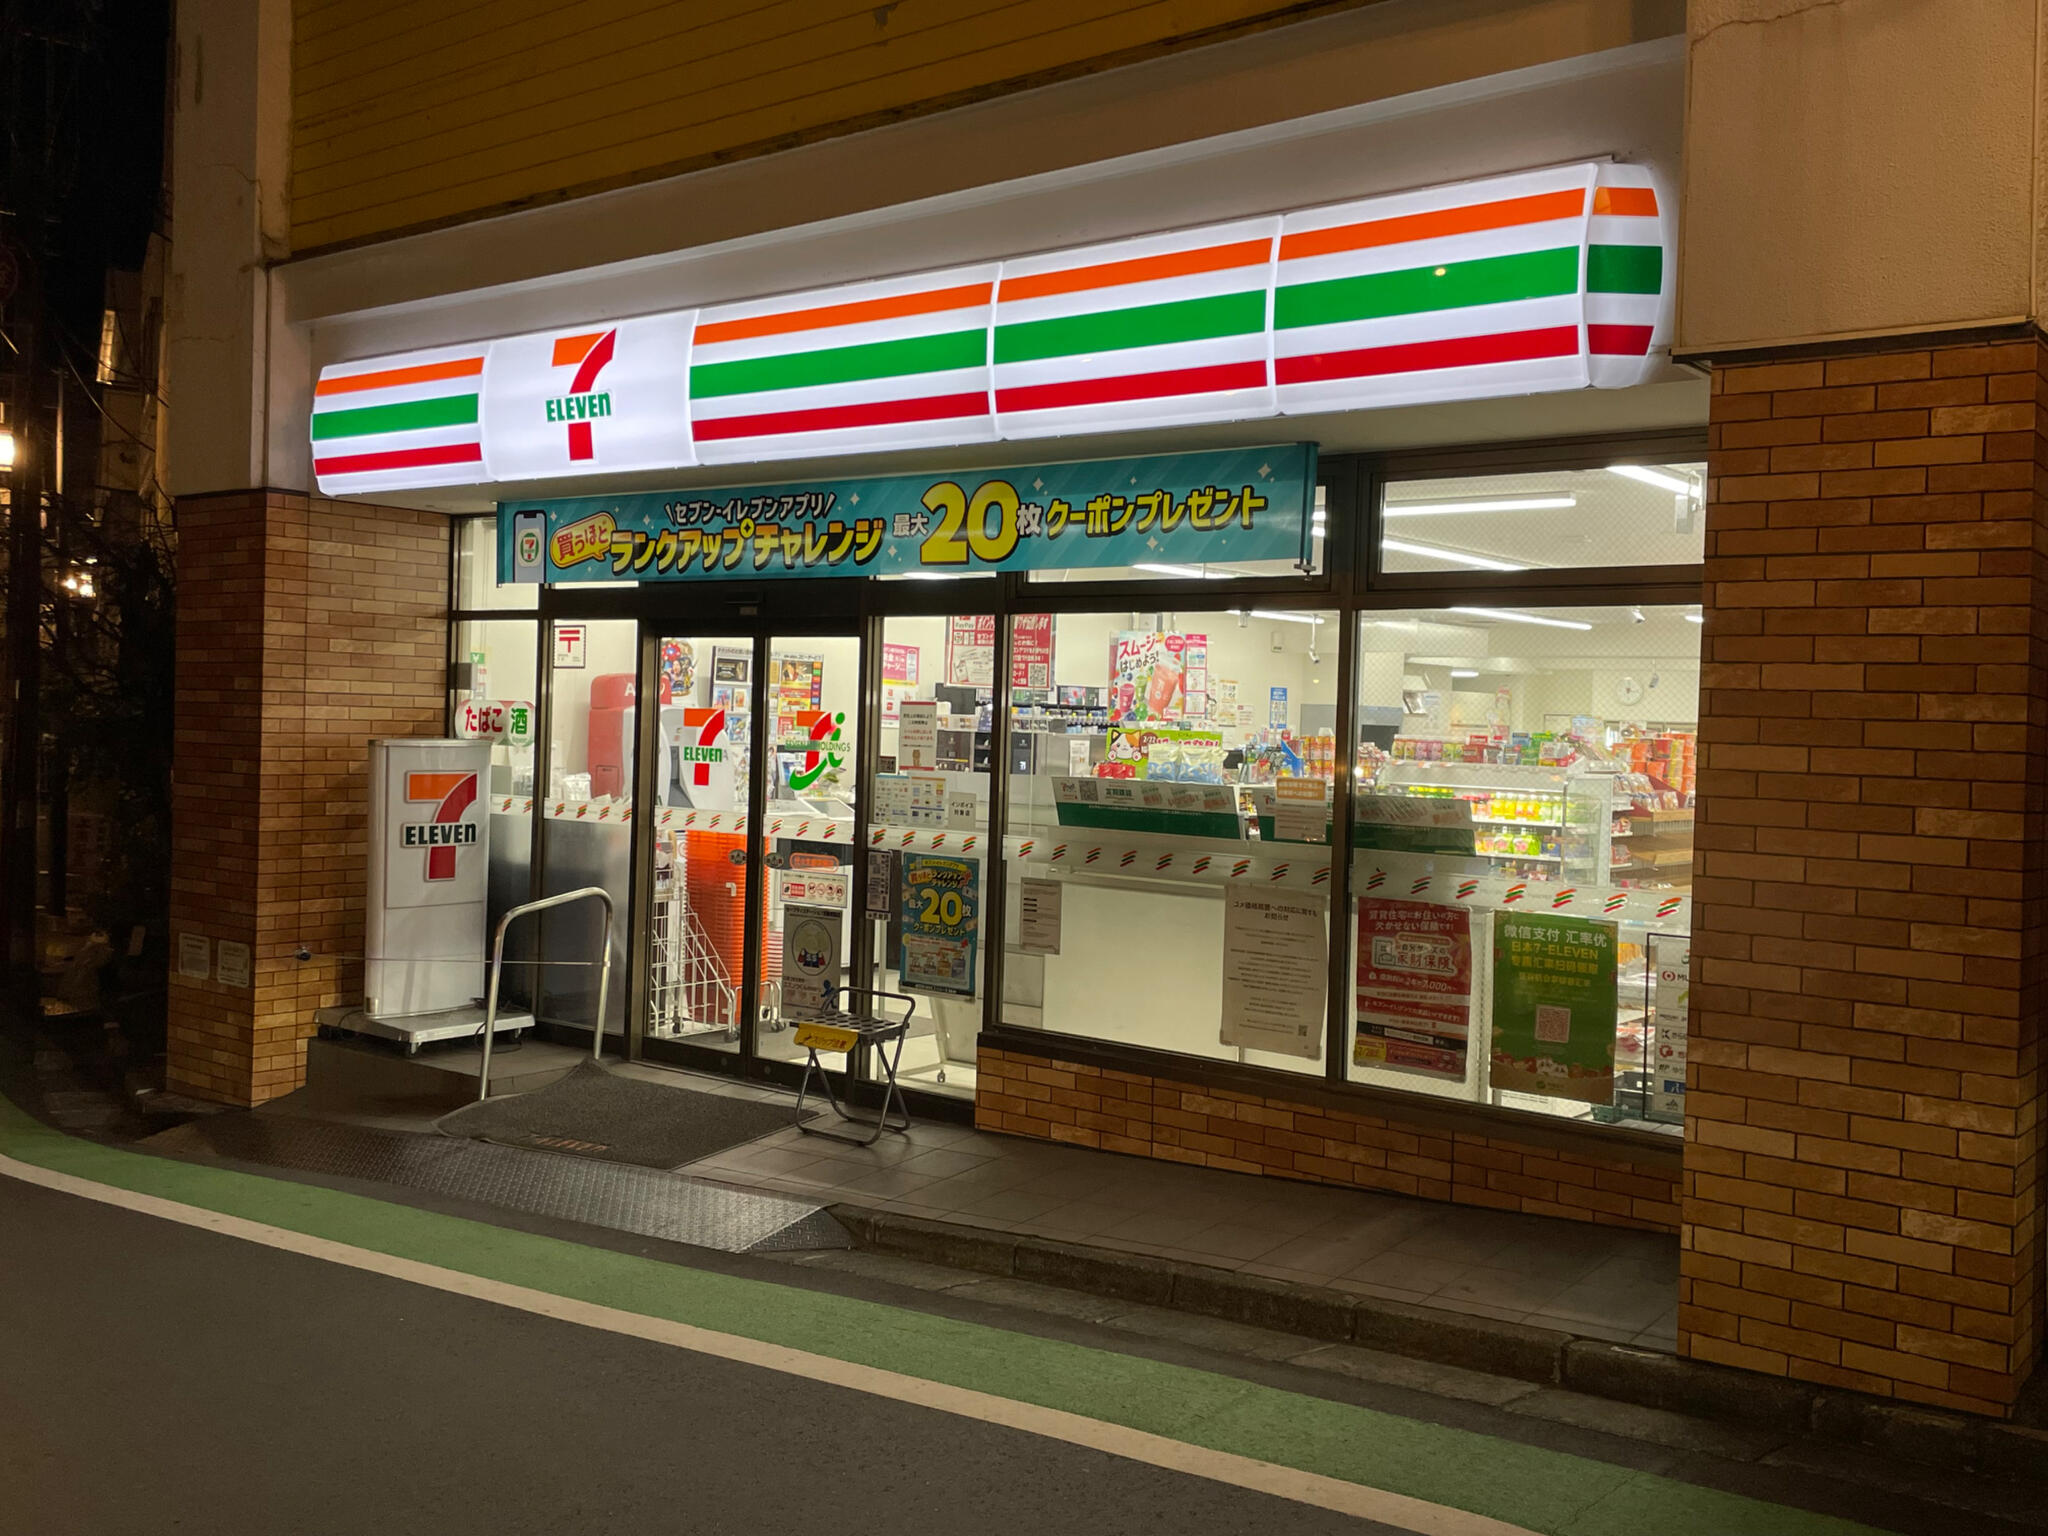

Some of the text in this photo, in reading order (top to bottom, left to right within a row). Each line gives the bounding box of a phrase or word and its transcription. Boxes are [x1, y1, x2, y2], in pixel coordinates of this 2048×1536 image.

[551, 328, 617, 461] 7
[556, 523, 609, 559] 買うほど
[610, 519, 884, 574] ランクアップチャレンジ
[1119, 633, 1162, 660] スムージー
[465, 706, 528, 734] たばこ 酒
[684, 708, 725, 786] 7
[408, 773, 478, 880] 7
